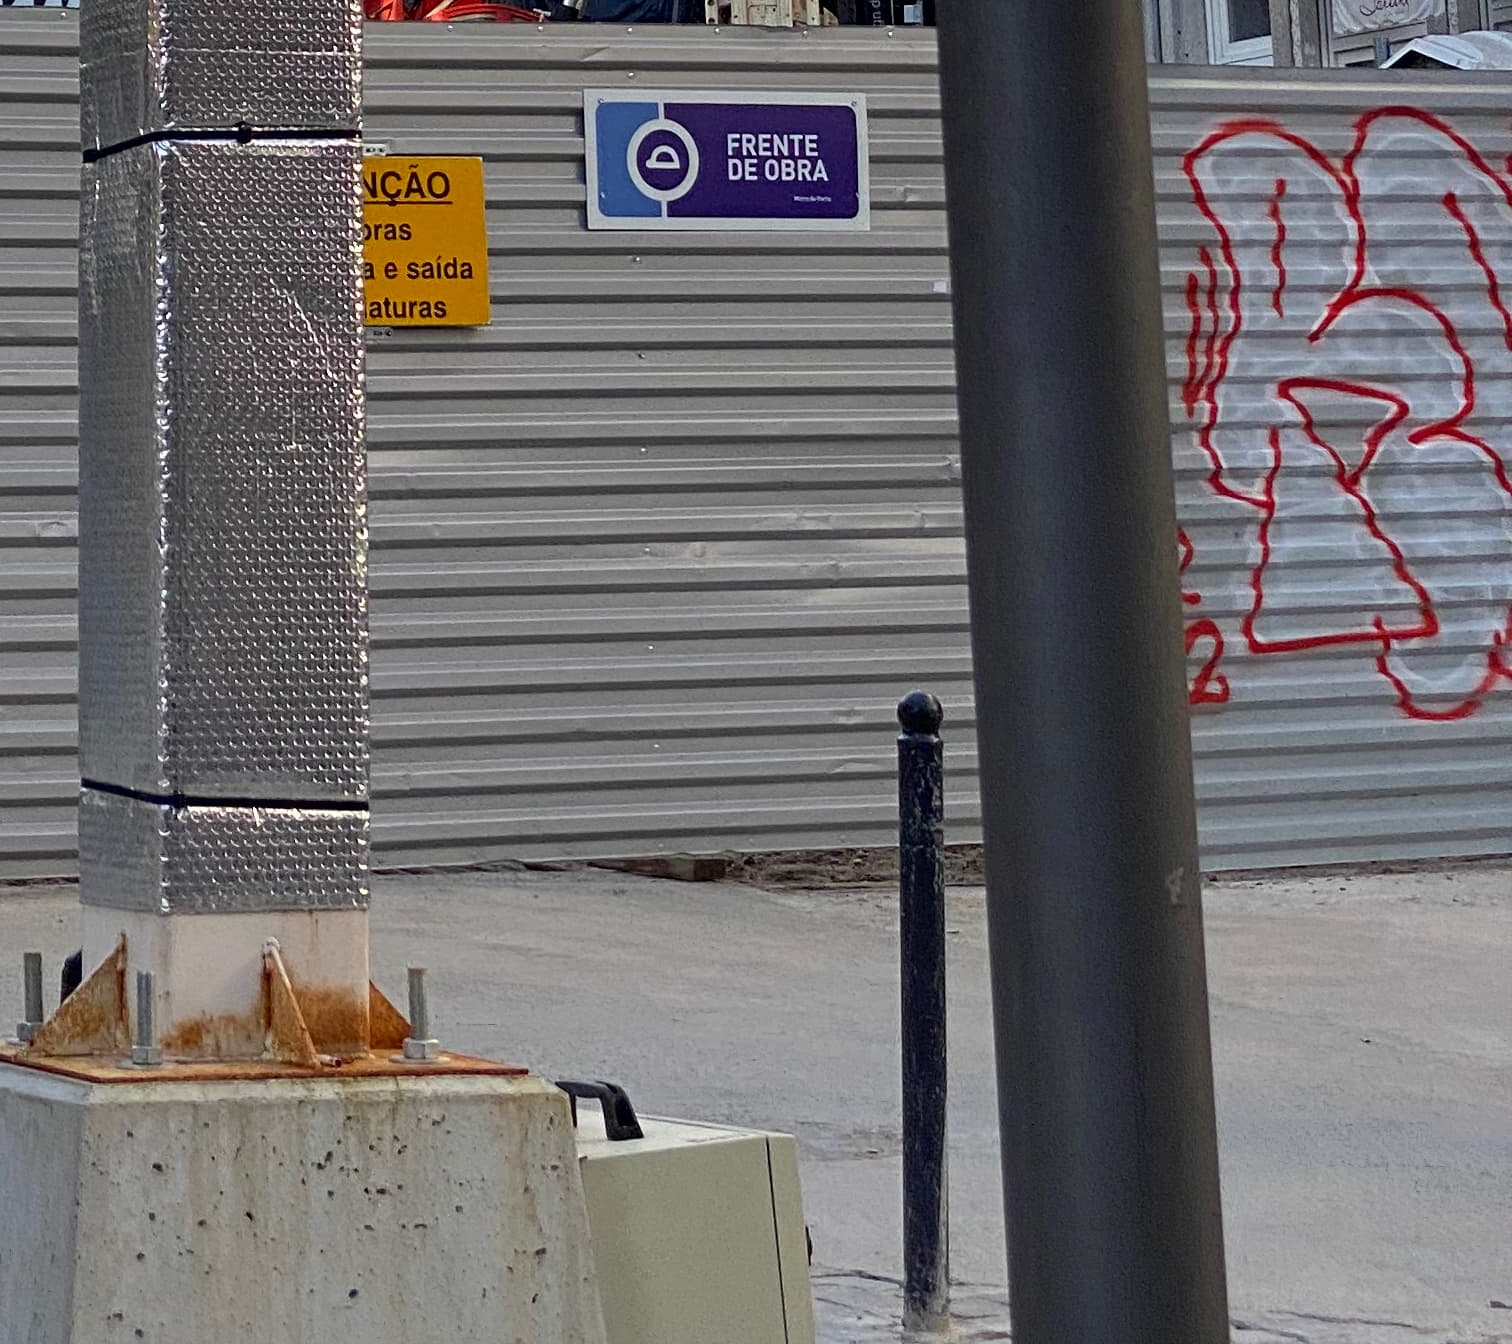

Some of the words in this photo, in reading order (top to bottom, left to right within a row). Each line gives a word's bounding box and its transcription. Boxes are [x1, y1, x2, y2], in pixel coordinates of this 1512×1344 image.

[727, 133, 819, 157] FRENTE
[727, 158, 759, 181] DE
[764, 158, 829, 182] OBRA
[384, 261, 398, 280] e
[406, 256, 473, 280] saída
